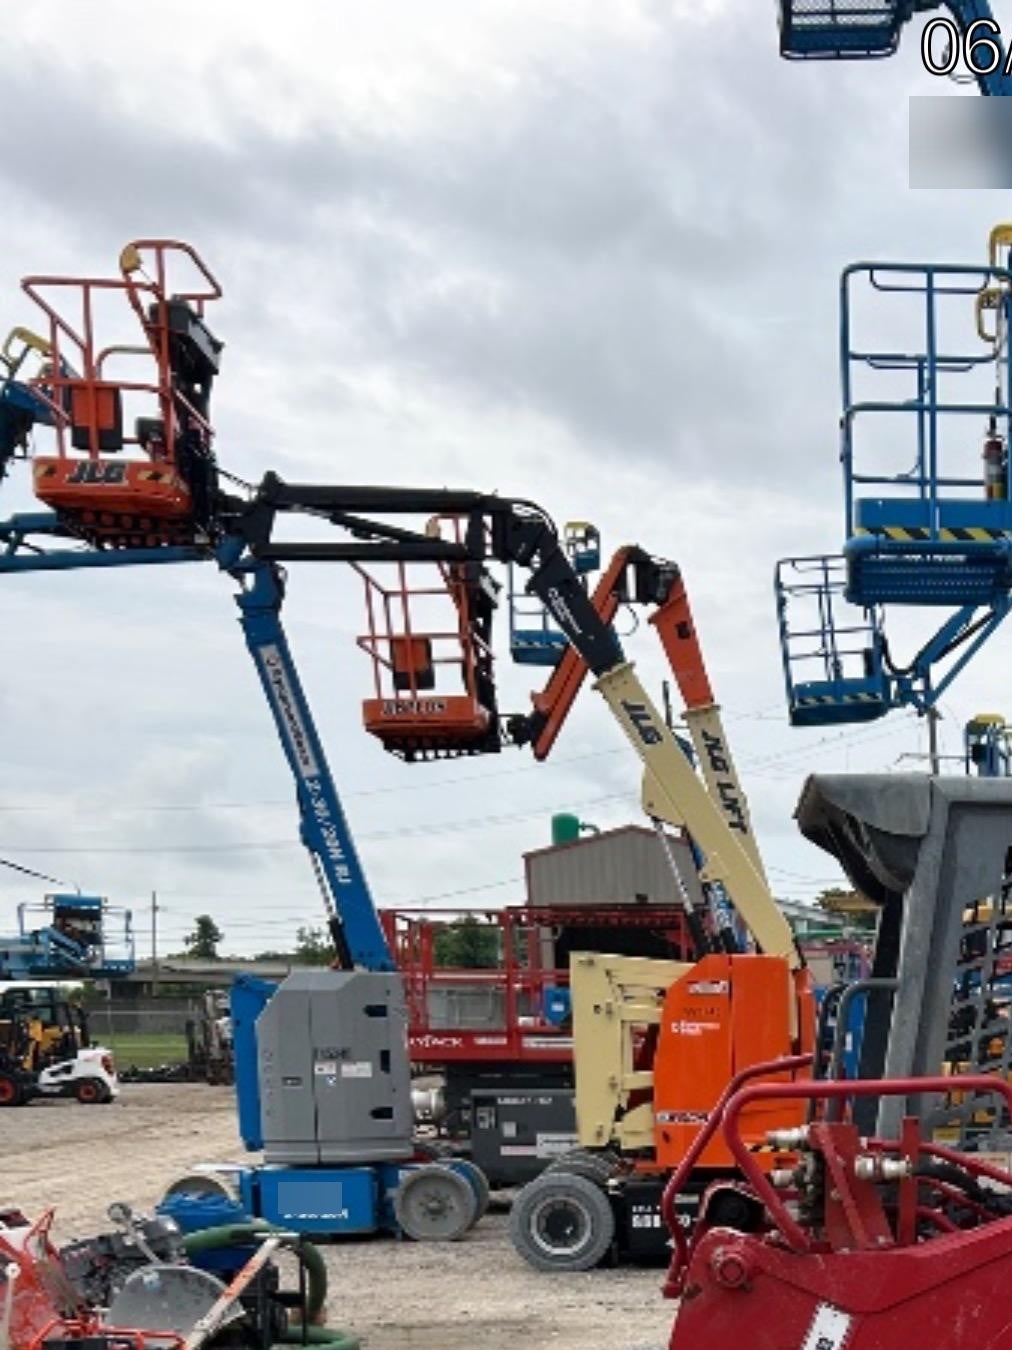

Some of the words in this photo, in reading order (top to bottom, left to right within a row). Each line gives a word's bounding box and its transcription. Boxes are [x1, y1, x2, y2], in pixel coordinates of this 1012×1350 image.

[64, 460, 127, 485] JLG
[621, 699, 663, 744] JLG
[702, 729, 729, 774] JLG
[716, 781, 747, 834] LIFT
